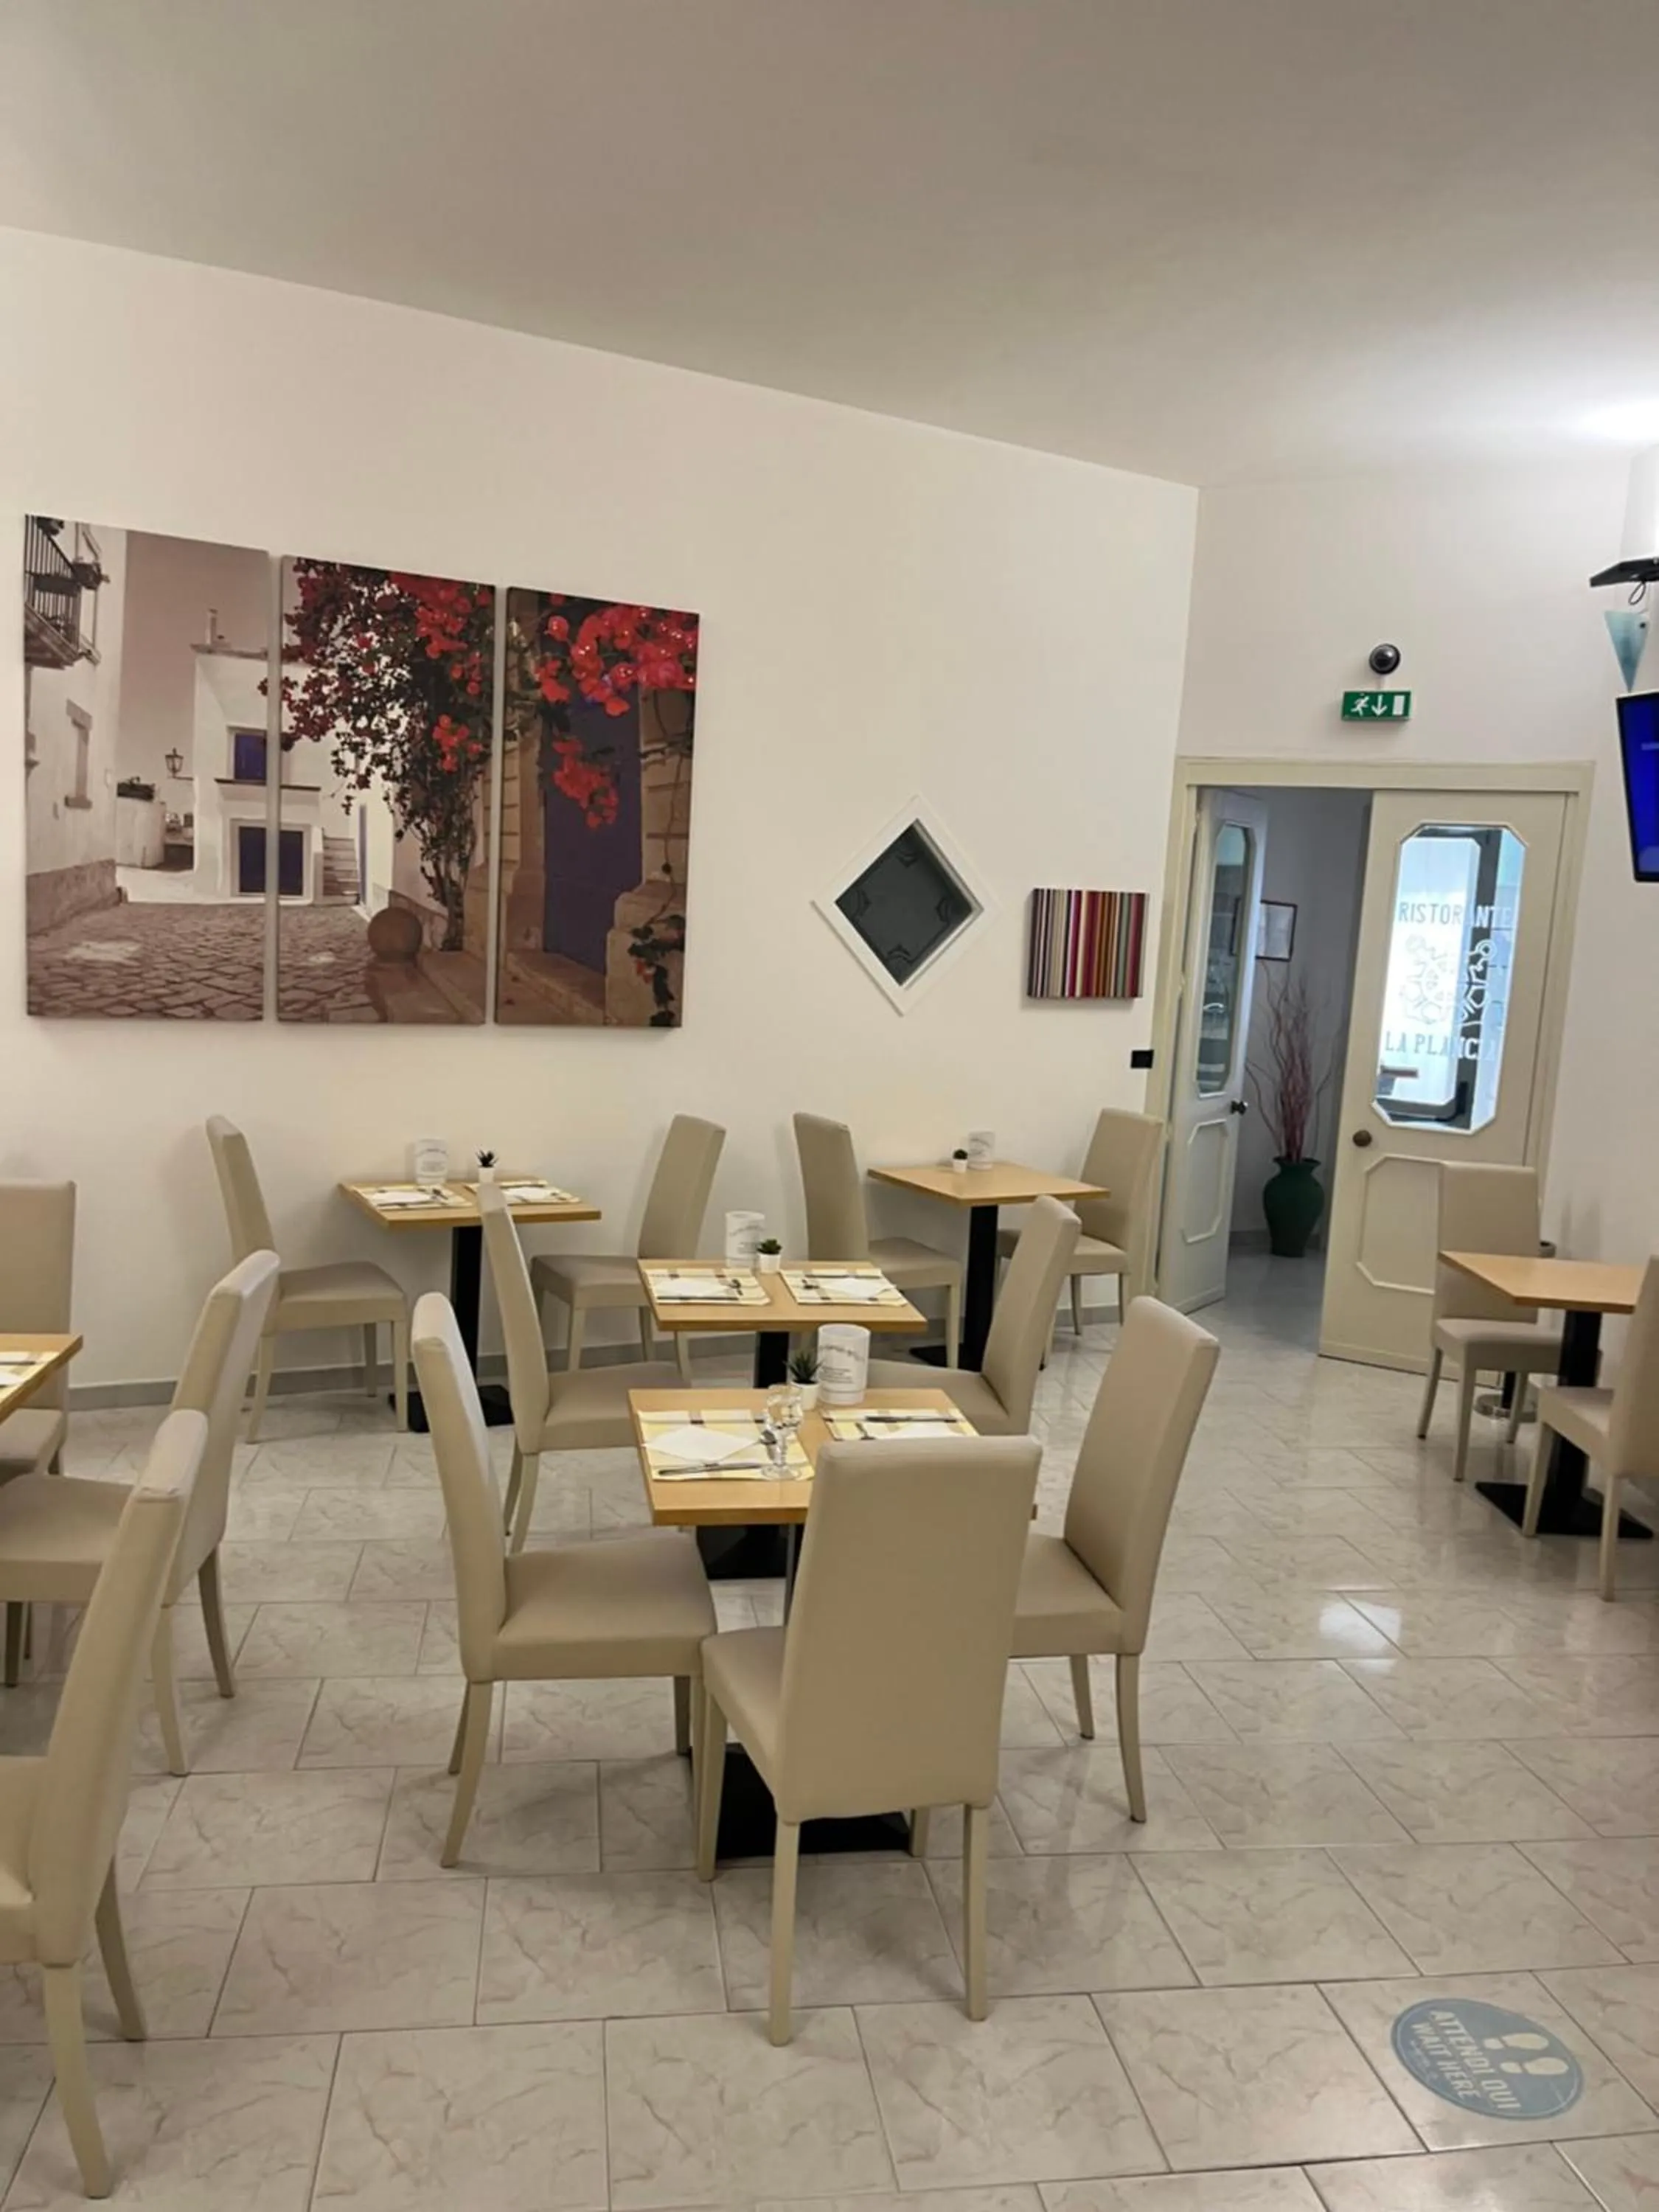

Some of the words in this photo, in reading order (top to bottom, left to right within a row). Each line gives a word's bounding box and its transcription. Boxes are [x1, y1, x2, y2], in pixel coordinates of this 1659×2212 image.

[1398, 901, 1512, 928] RISTORNTE
[1385, 1031, 1407, 1053] LA
[1410, 2023, 1453, 2056] WAIT
[1436, 2061, 1482, 2100] HERE
[1428, 2010, 1495, 2074] ATTENDI
[1481, 2079, 1522, 2109] QUI
